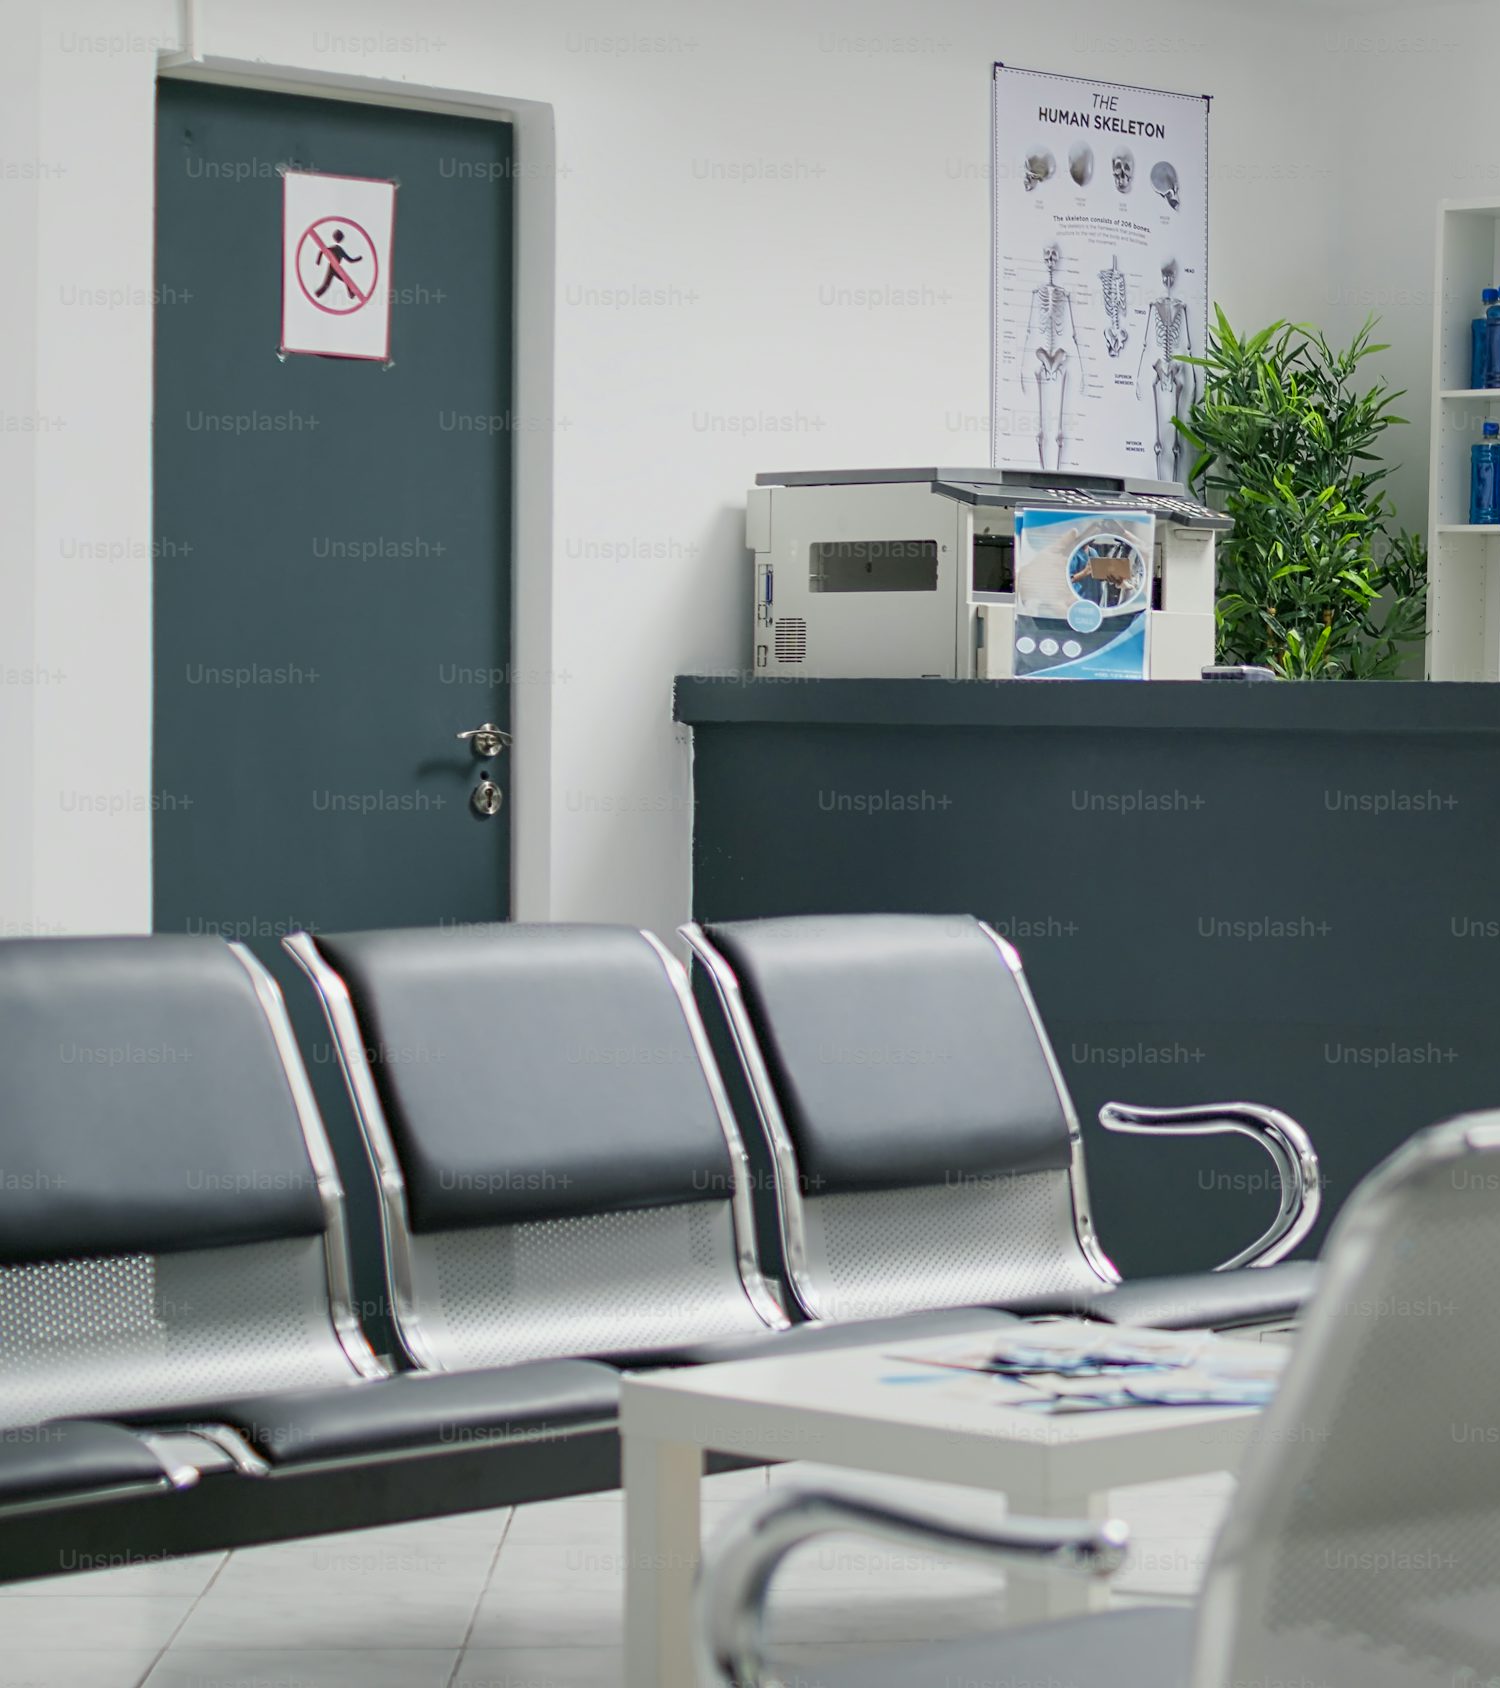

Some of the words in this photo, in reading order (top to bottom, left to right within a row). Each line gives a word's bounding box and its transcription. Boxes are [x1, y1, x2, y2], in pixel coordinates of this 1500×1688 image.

[1092, 93, 1119, 111] THE
[1039, 106, 1090, 128] HUMAN
[1094, 115, 1165, 139] SKELETON
[1090, 217, 1113, 225] consists
[1121, 220, 1132, 228] 206
[1133, 223, 1151, 233] bones.
